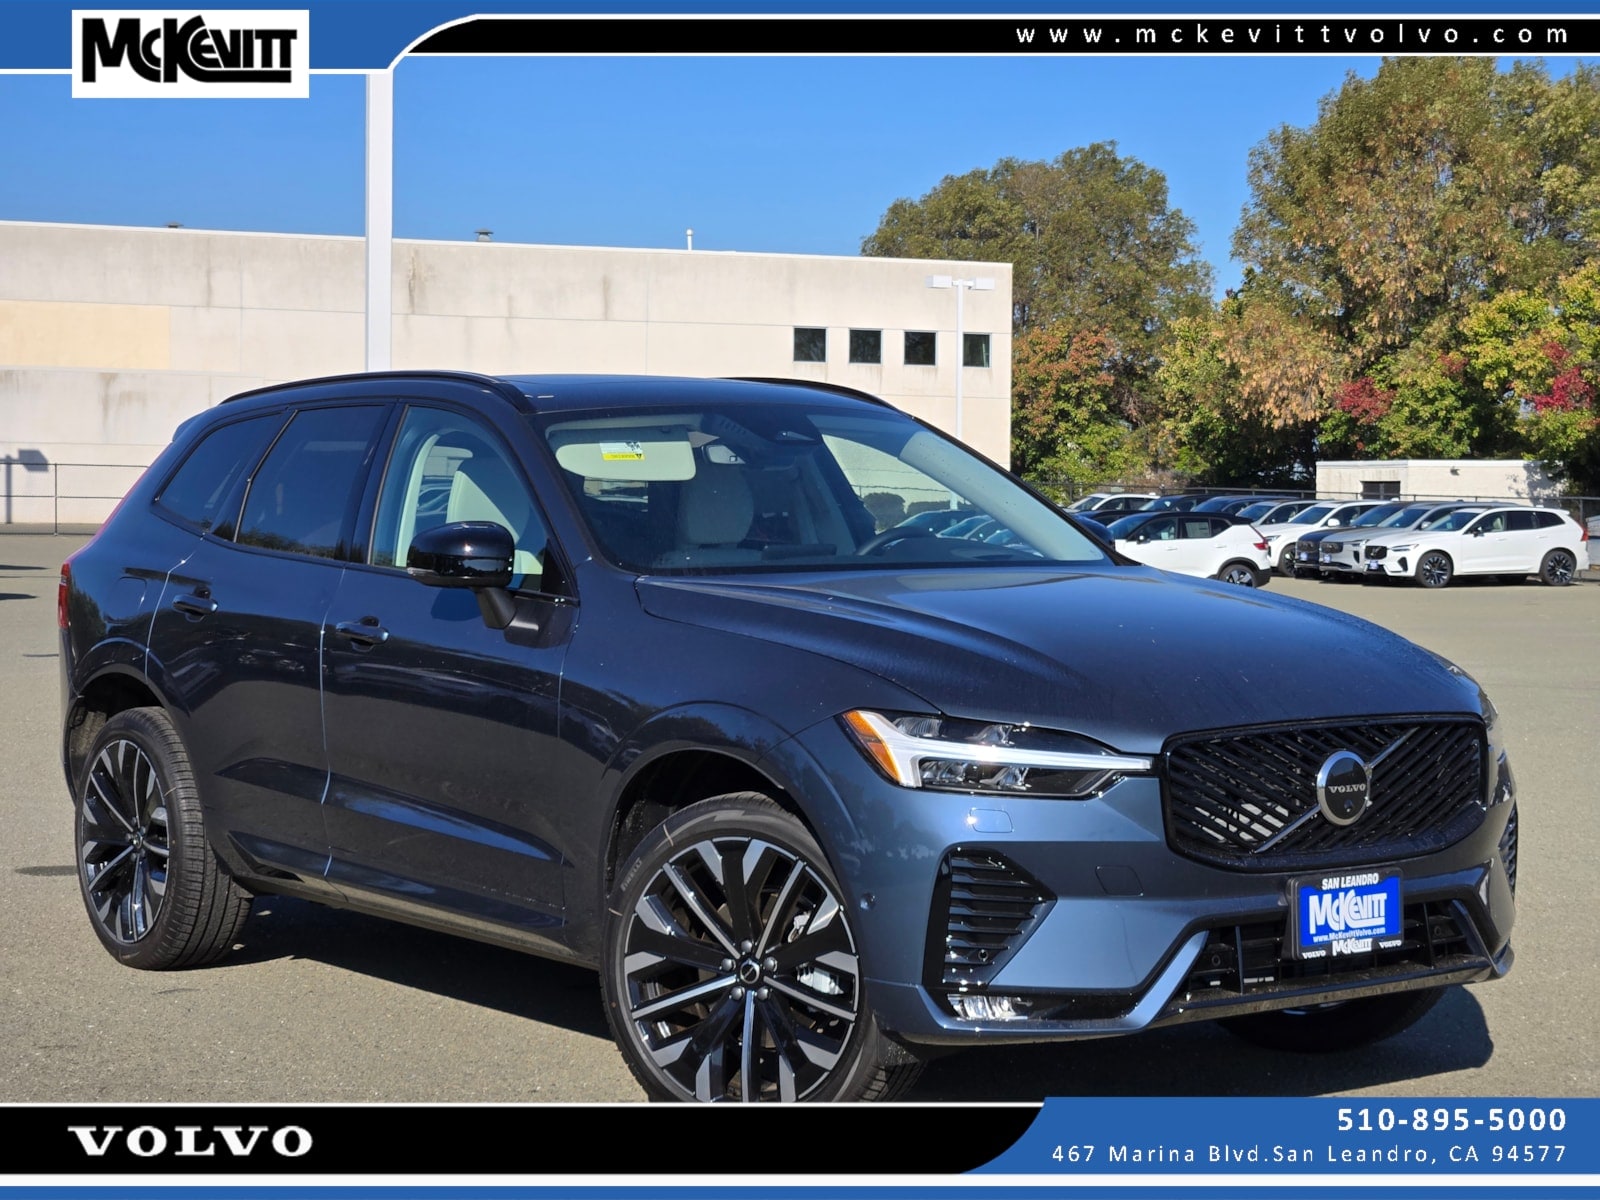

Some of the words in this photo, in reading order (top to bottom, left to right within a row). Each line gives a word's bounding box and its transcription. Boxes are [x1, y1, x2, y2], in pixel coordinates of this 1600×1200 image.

[1328, 783, 1366, 794] VOLVO
[1321, 876, 1340, 891] SAN
[1341, 872, 1380, 888] LEANDRO
[1302, 950, 1327, 960] VOLVO
